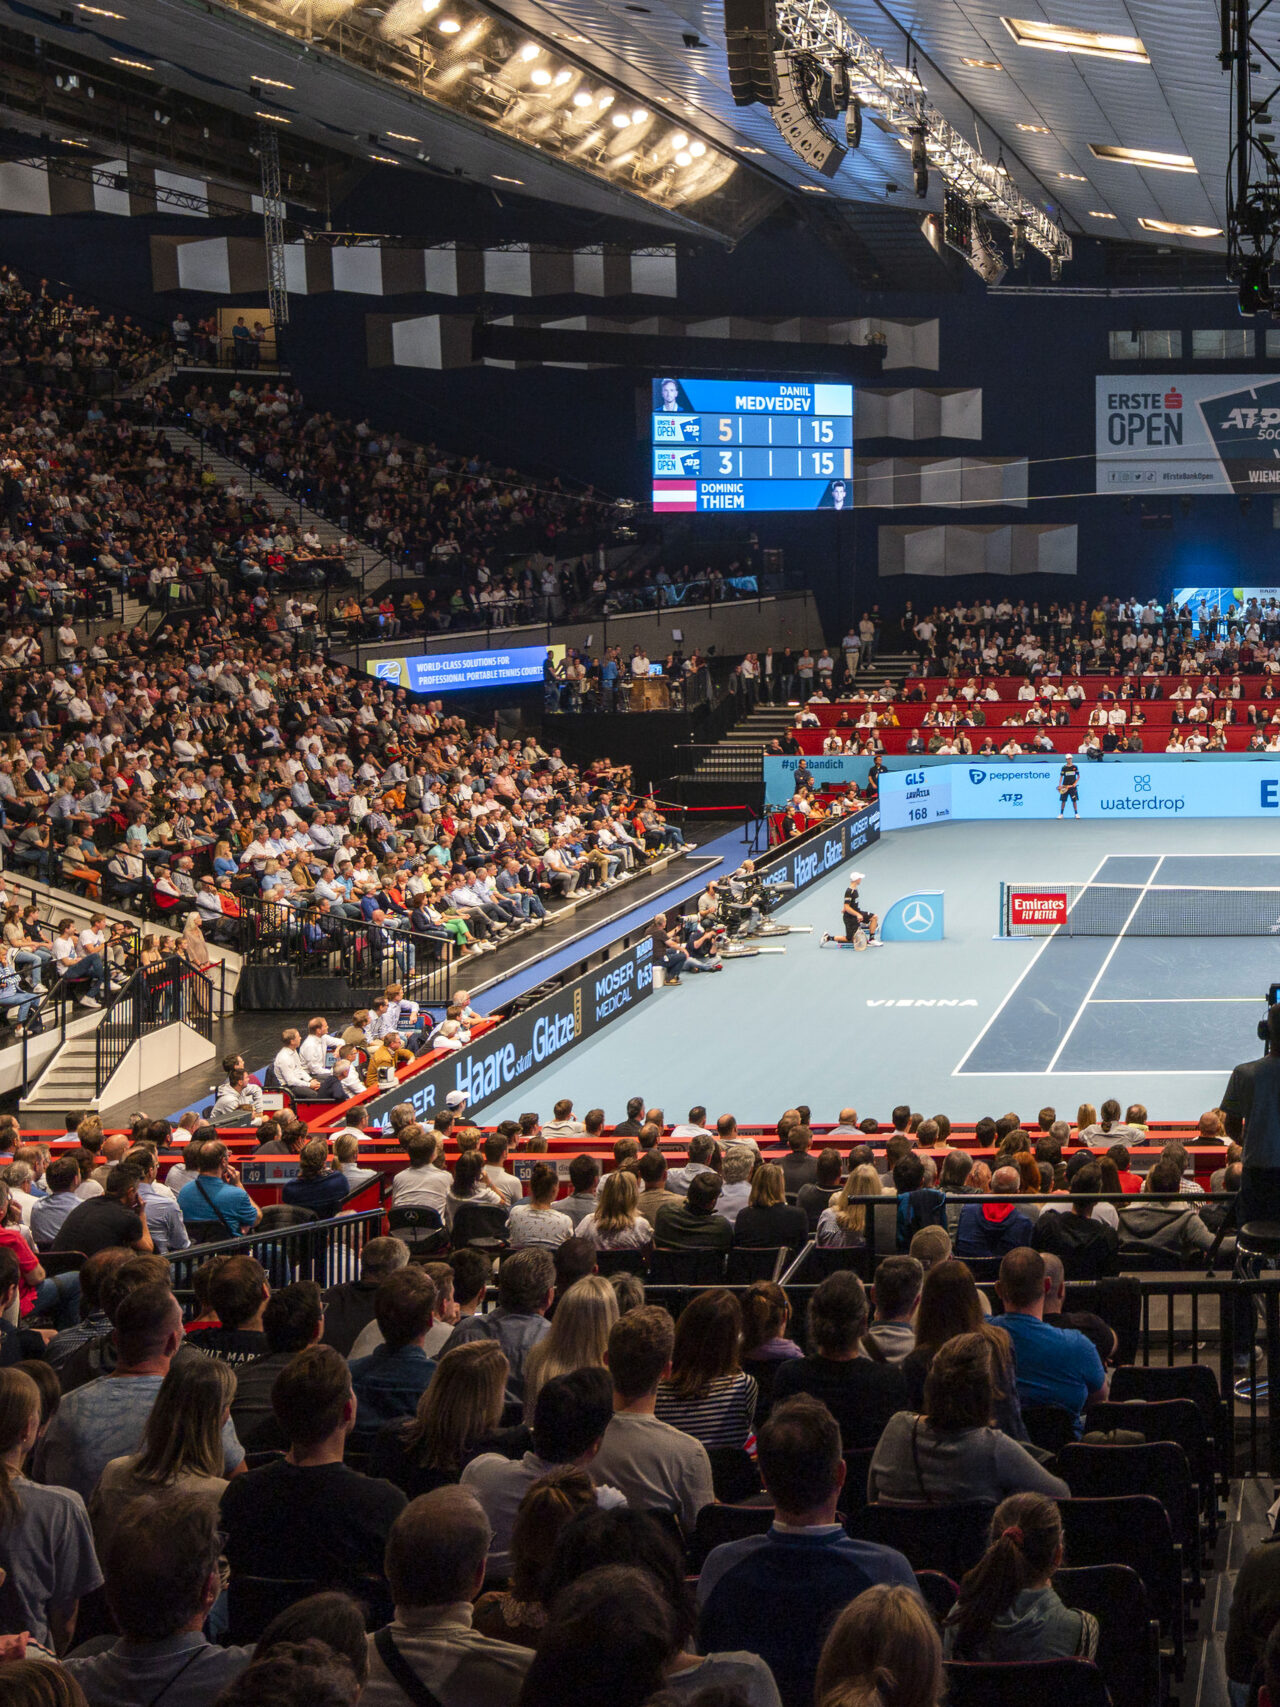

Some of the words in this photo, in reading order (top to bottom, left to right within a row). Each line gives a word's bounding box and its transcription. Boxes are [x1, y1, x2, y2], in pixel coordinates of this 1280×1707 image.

[780, 386, 811, 396] DANIIL
[735, 396, 811, 411] MEDVEDEV
[1108, 393, 1161, 409] ERSTE
[657, 426, 676, 437] OPEN
[718, 418, 733, 442] 5
[811, 421, 834, 443] 15
[1108, 413, 1183, 446] OPEN
[657, 460, 676, 471] OPEN
[718, 451, 733, 474] 3
[811, 452, 834, 475] 15
[1162, 472, 1214, 481] #ErsteBankOpen
[701, 483, 744, 493] DOMINIC
[701, 495, 745, 509] THIEM
[416, 660, 462, 673] WORLD-CLASS
[462, 657, 497, 669] SOLUTIONS
[497, 655, 511, 665] FOR
[418, 672, 466, 686] PROFESSIONAL
[466, 670, 498, 682] PORTABLE
[499, 667, 521, 679] TENNIS
[989, 770, 1051, 781] pepperstone
[906, 788, 930, 800] LAVAZZA
[999, 793, 1023, 802] ATP
[1101, 796, 1185, 812] waterdrop
[908, 807, 928, 821] 168
[1014, 898, 1065, 910] Emirates
[1022, 910, 1033, 920] FLY
[1034, 910, 1057, 920] BETTER
[596, 961, 634, 1001] MOSER
[637, 963, 653, 990] 0:53
[595, 986, 632, 1022] MEDICAL
[865, 999, 979, 1007] VIENNA
[456, 1042, 515, 1108] Haare
[532, 1012, 575, 1062] Glatze
[248, 1170, 260, 1181] 49
[519, 1167, 531, 1179] 50
